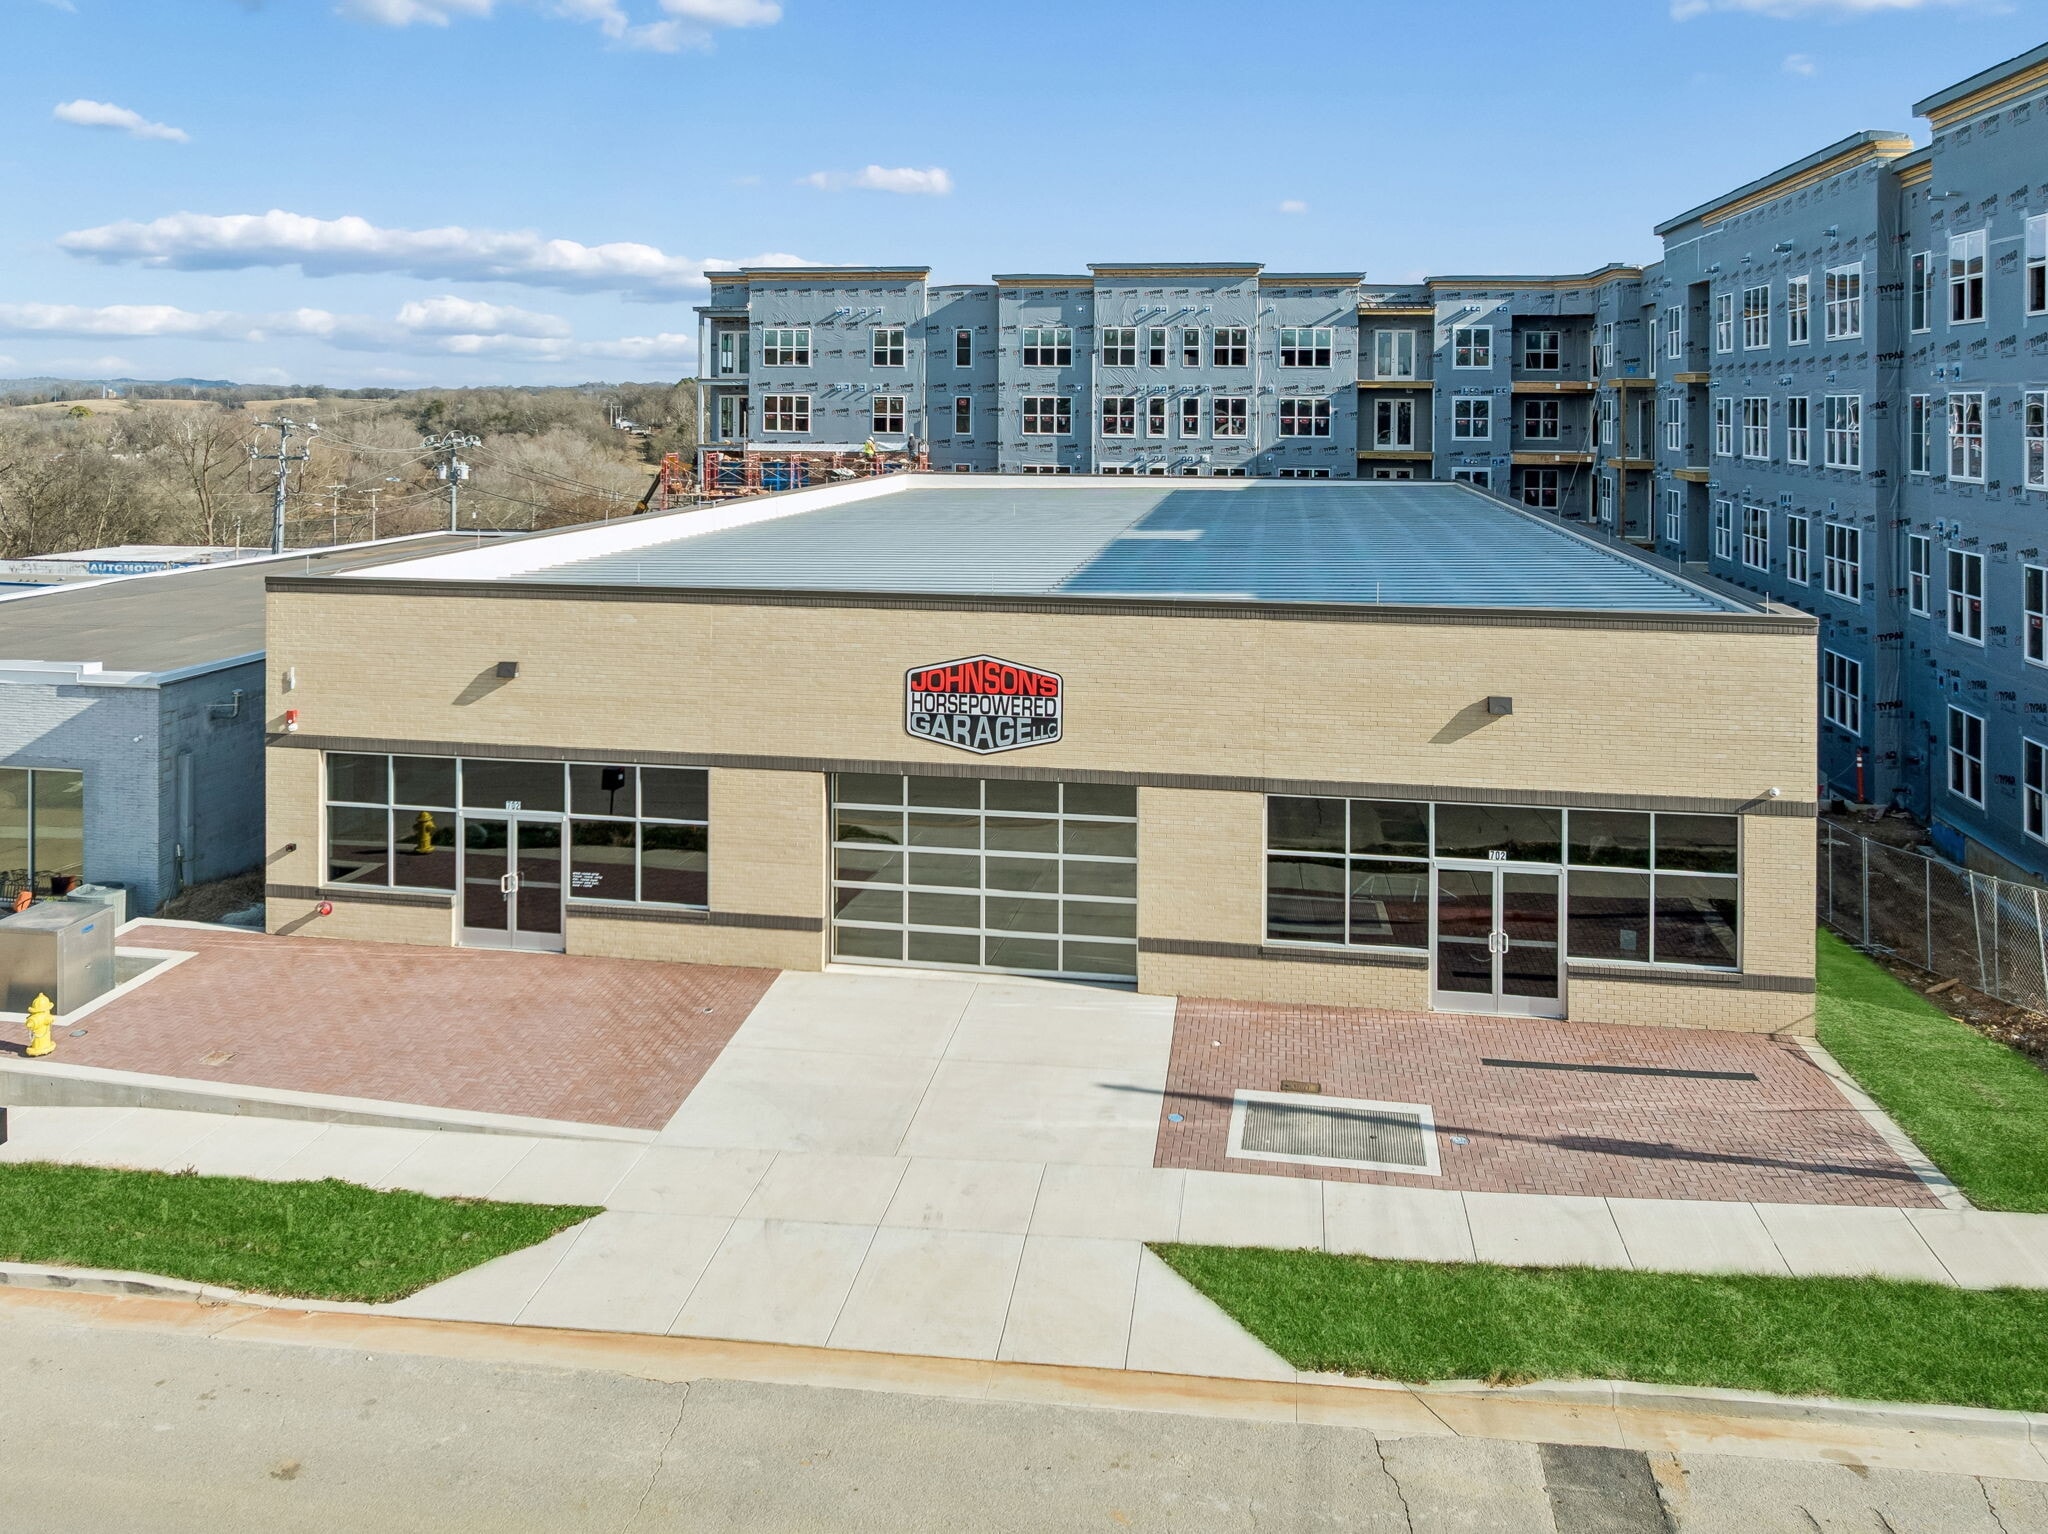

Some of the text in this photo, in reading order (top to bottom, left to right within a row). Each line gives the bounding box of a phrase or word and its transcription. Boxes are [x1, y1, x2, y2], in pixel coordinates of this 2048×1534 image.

[911, 660, 1058, 695] JOHNSON'S
[911, 692, 1057, 717] HORSEPOWERED
[911, 713, 1057, 748] GARAGE LLC
[1490, 850, 1506, 860] 702
